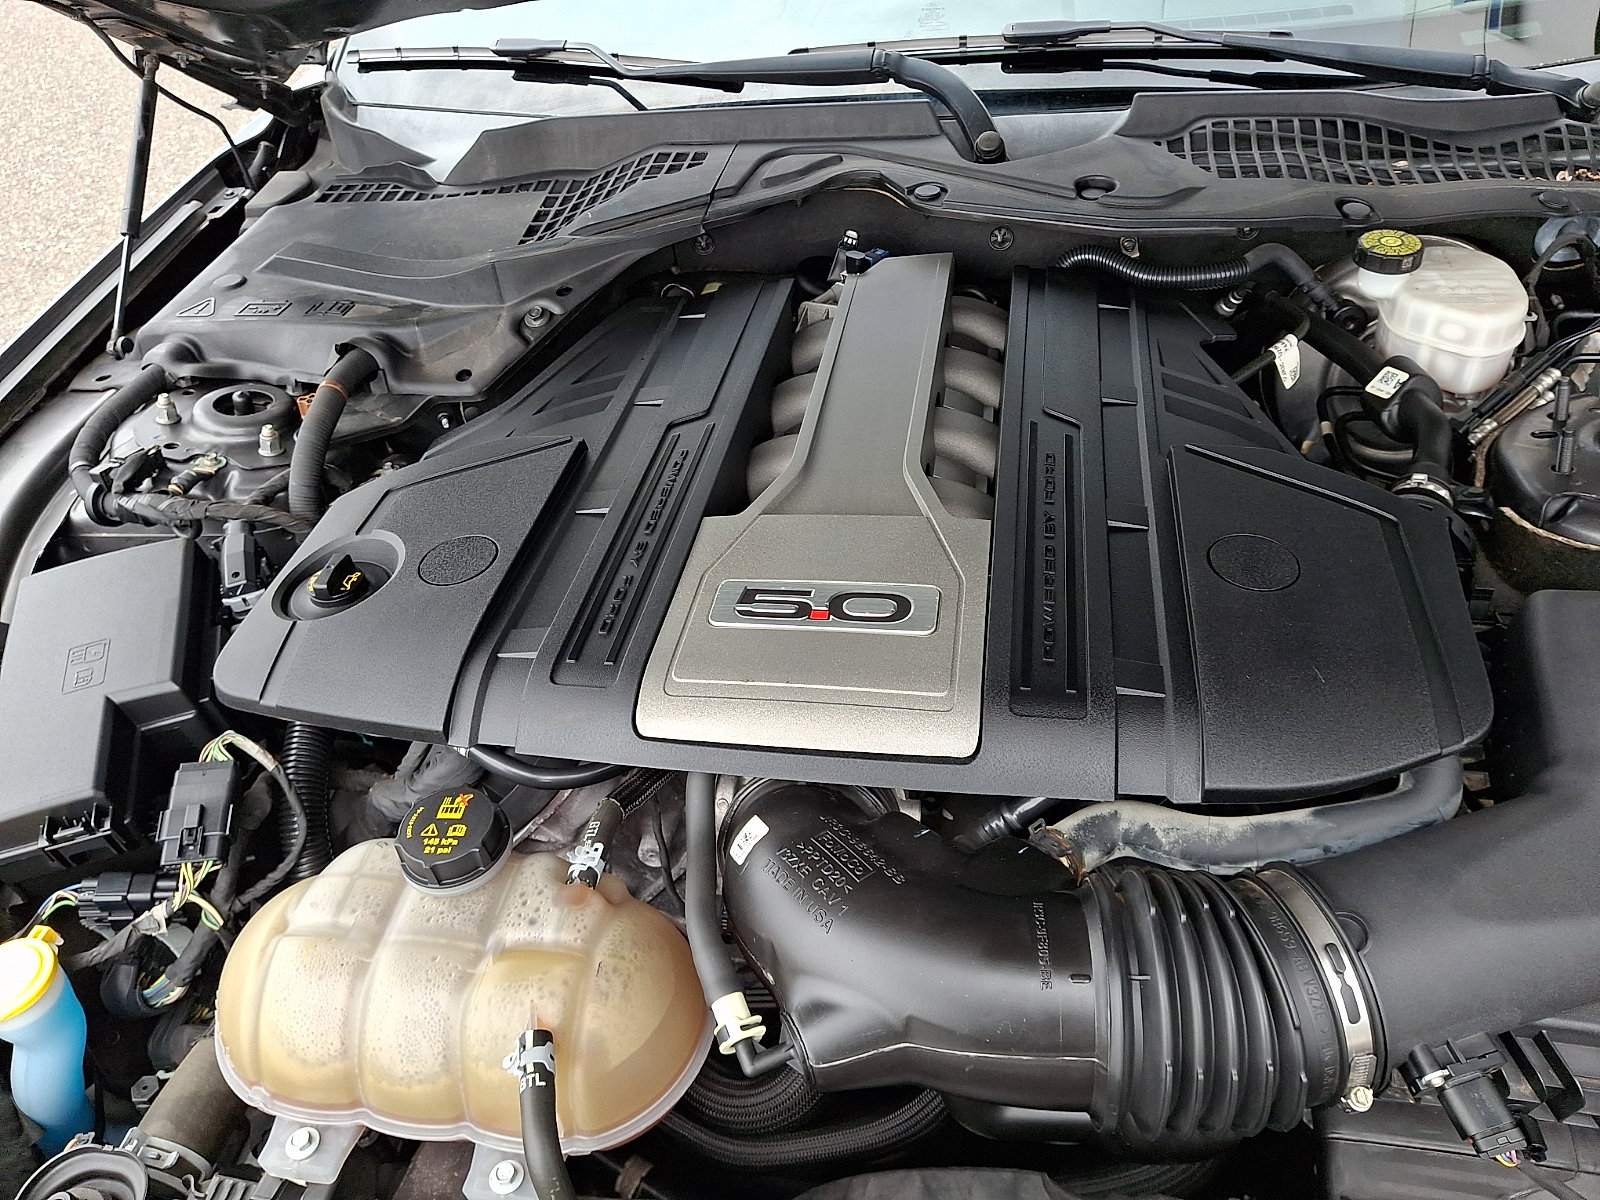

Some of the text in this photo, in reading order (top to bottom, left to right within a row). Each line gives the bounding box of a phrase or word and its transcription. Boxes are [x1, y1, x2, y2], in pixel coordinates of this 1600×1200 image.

[599, 449, 688, 635] POWERED BY FORD
[1042, 452, 1056, 662] POWERED BY FORD
[733, 586, 915, 624] 5.0
[584, 821, 600, 842] BTL
[423, 846, 436, 854] 21
[761, 857, 835, 935] MADE IN USA
[811, 877, 842, 906] CAV
[519, 1072, 547, 1094] BTL
